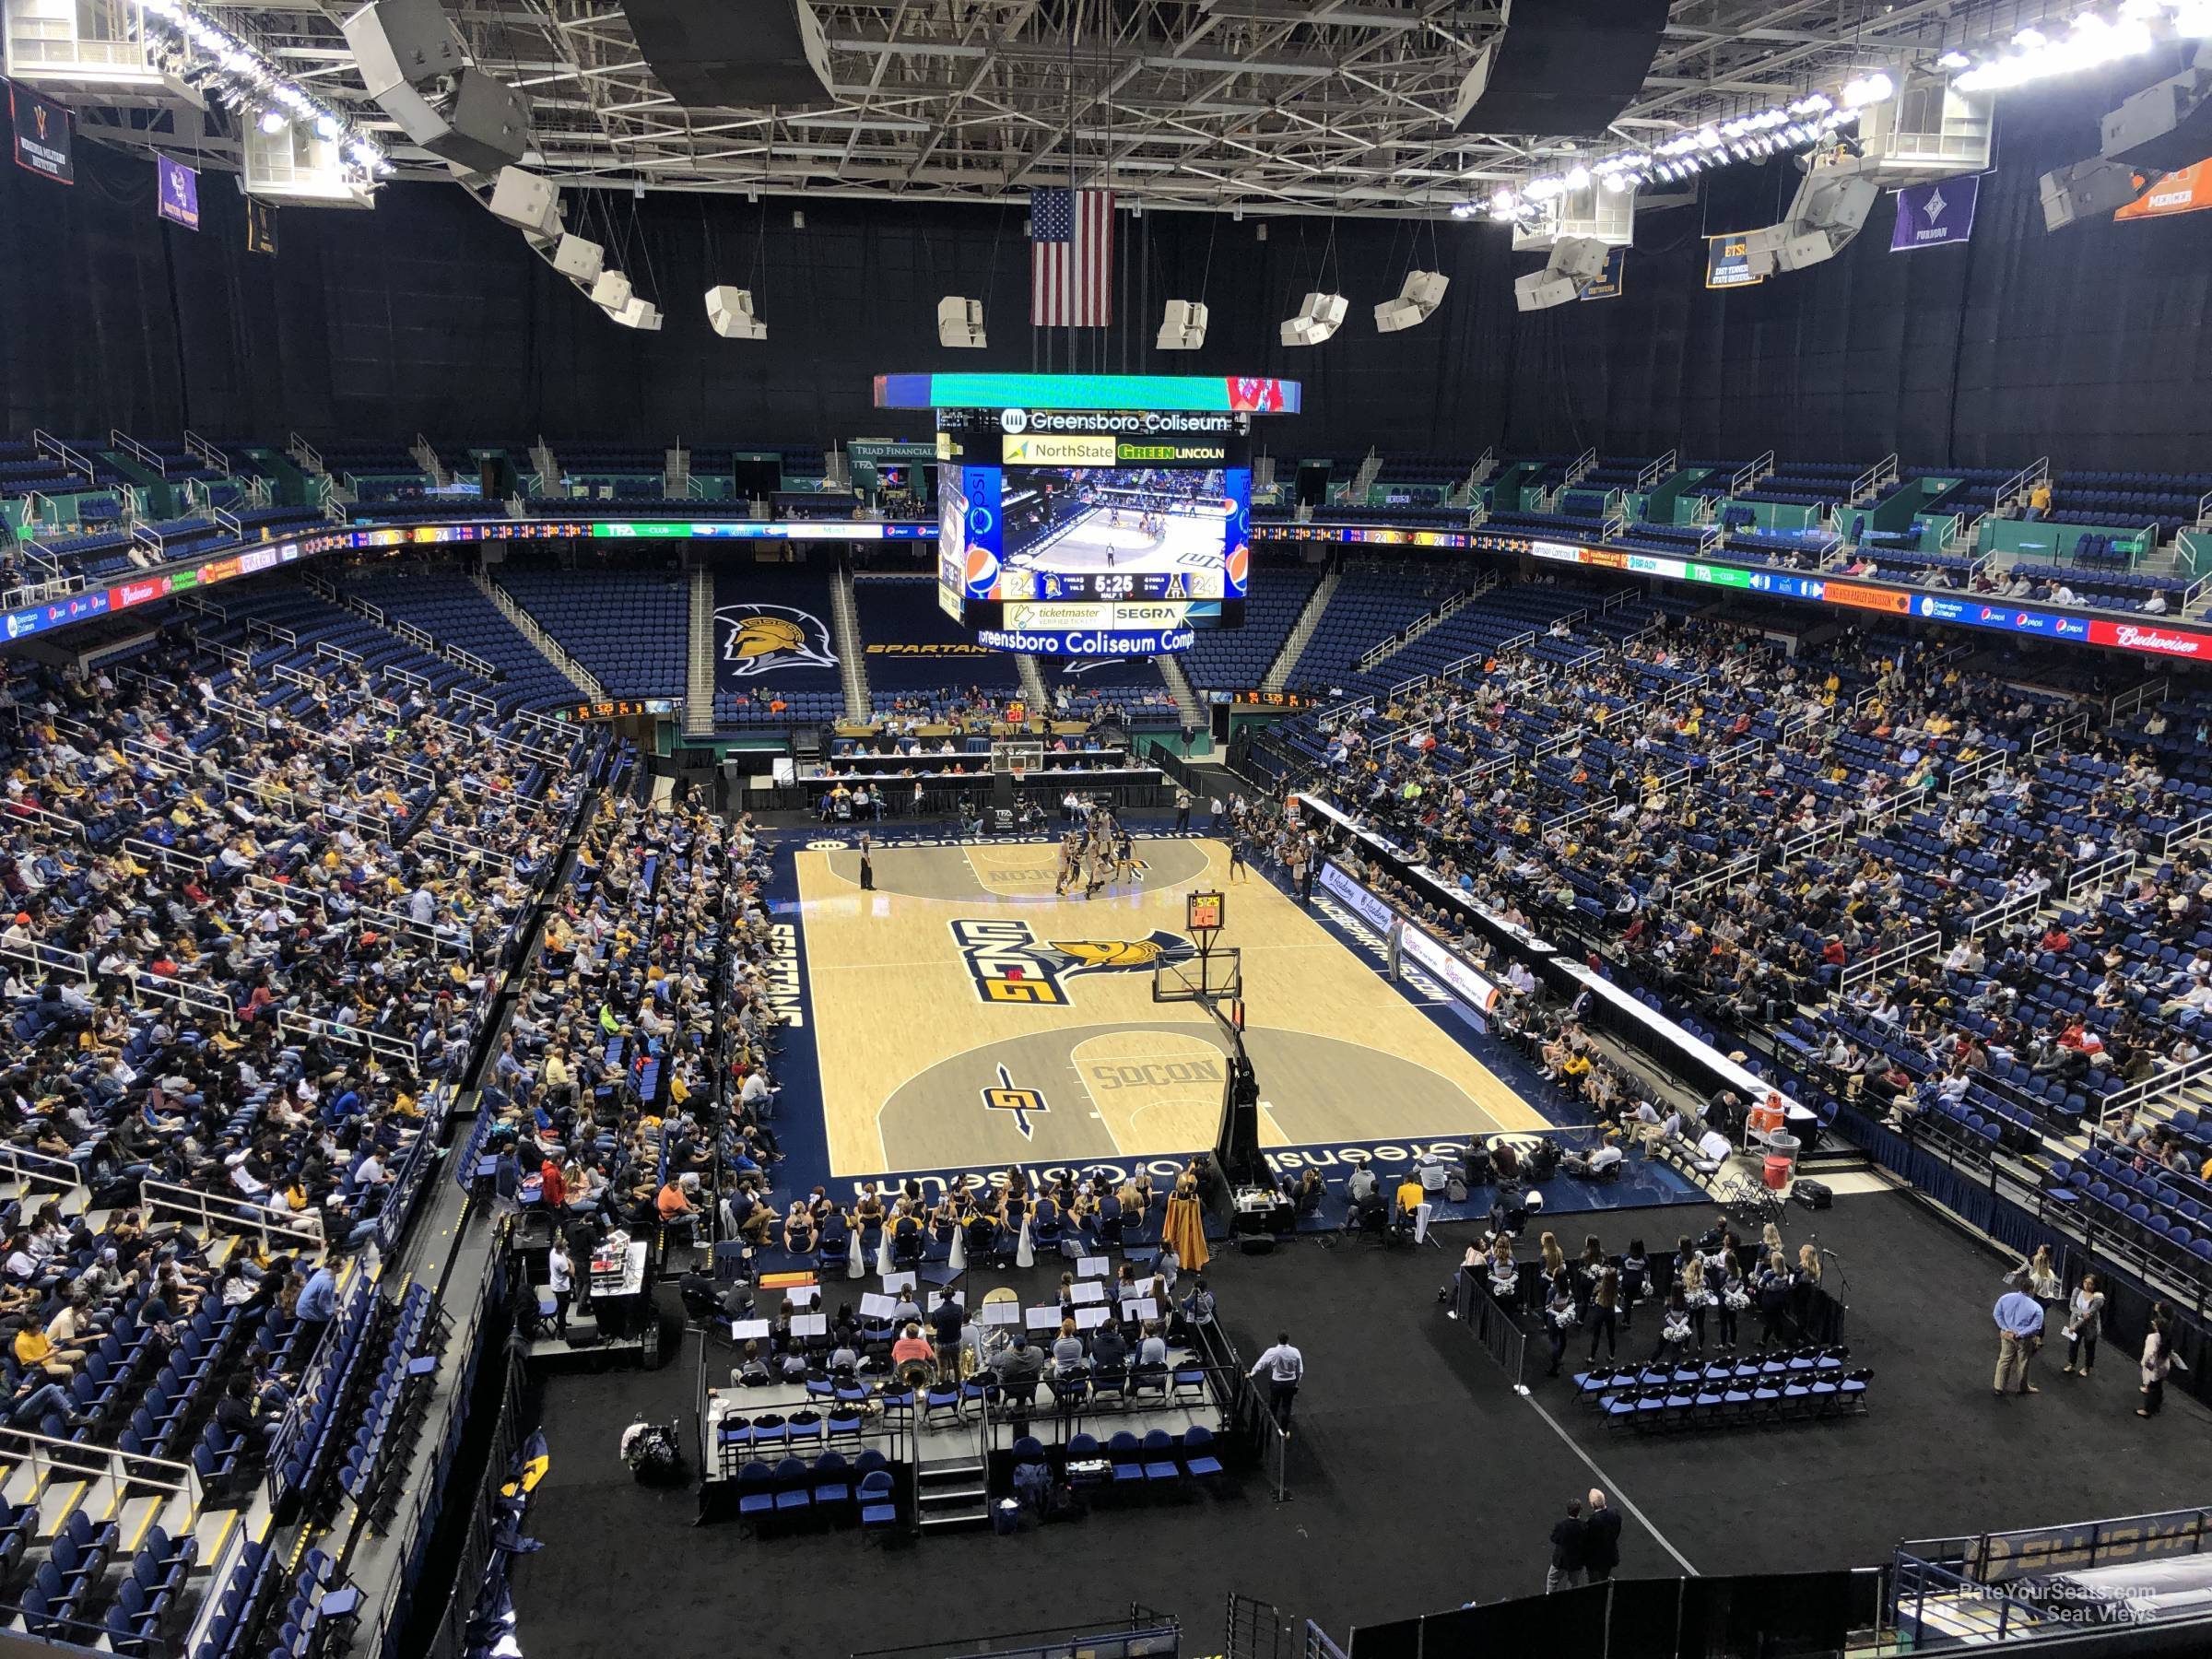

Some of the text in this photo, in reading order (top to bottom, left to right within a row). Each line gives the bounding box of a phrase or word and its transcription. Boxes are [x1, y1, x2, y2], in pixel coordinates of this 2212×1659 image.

[2147, 190, 2193, 208] MERCER
[1916, 227, 1948, 241] FURMAN
[1030, 412, 1229, 431] Greensboro Coliseum
[855, 446, 933, 457] TRIAD FINANCIAL
[1035, 443, 1114, 458] NorthState
[1117, 443, 1225, 460] GREEN LINCOLN
[853, 460, 876, 470] TFA
[606, 524, 637, 536] TFA
[435, 531, 449, 542] 24
[1374, 533, 1387, 543] 24
[1433, 535, 1445, 547] 24
[1634, 558, 1657, 570] BRADY
[1011, 577, 1036, 596] 24
[1094, 575, 1134, 593] 5:25
[1193, 577, 1217, 595] 24
[1038, 607, 1100, 618] ticketmaster
[1116, 607, 1176, 618] SEGRA
[1933, 608, 1957, 618] Coliseum
[1934, 601, 1963, 613] Greensboro
[1990, 612, 2006, 622] pepsi
[2028, 618, 2043, 628] pepsi
[2065, 623, 2083, 633] pepsi
[1065, 630, 1156, 653] Coliseum
[2116, 627, 2199, 653] Budweiser
[865, 644, 1004, 653] SPARTAN
[860, 835, 1049, 849] Greensboro
[1333, 874, 1356, 902] Academy
[1366, 899, 1390, 929] Academy
[959, 920, 1060, 1004] UNCG
